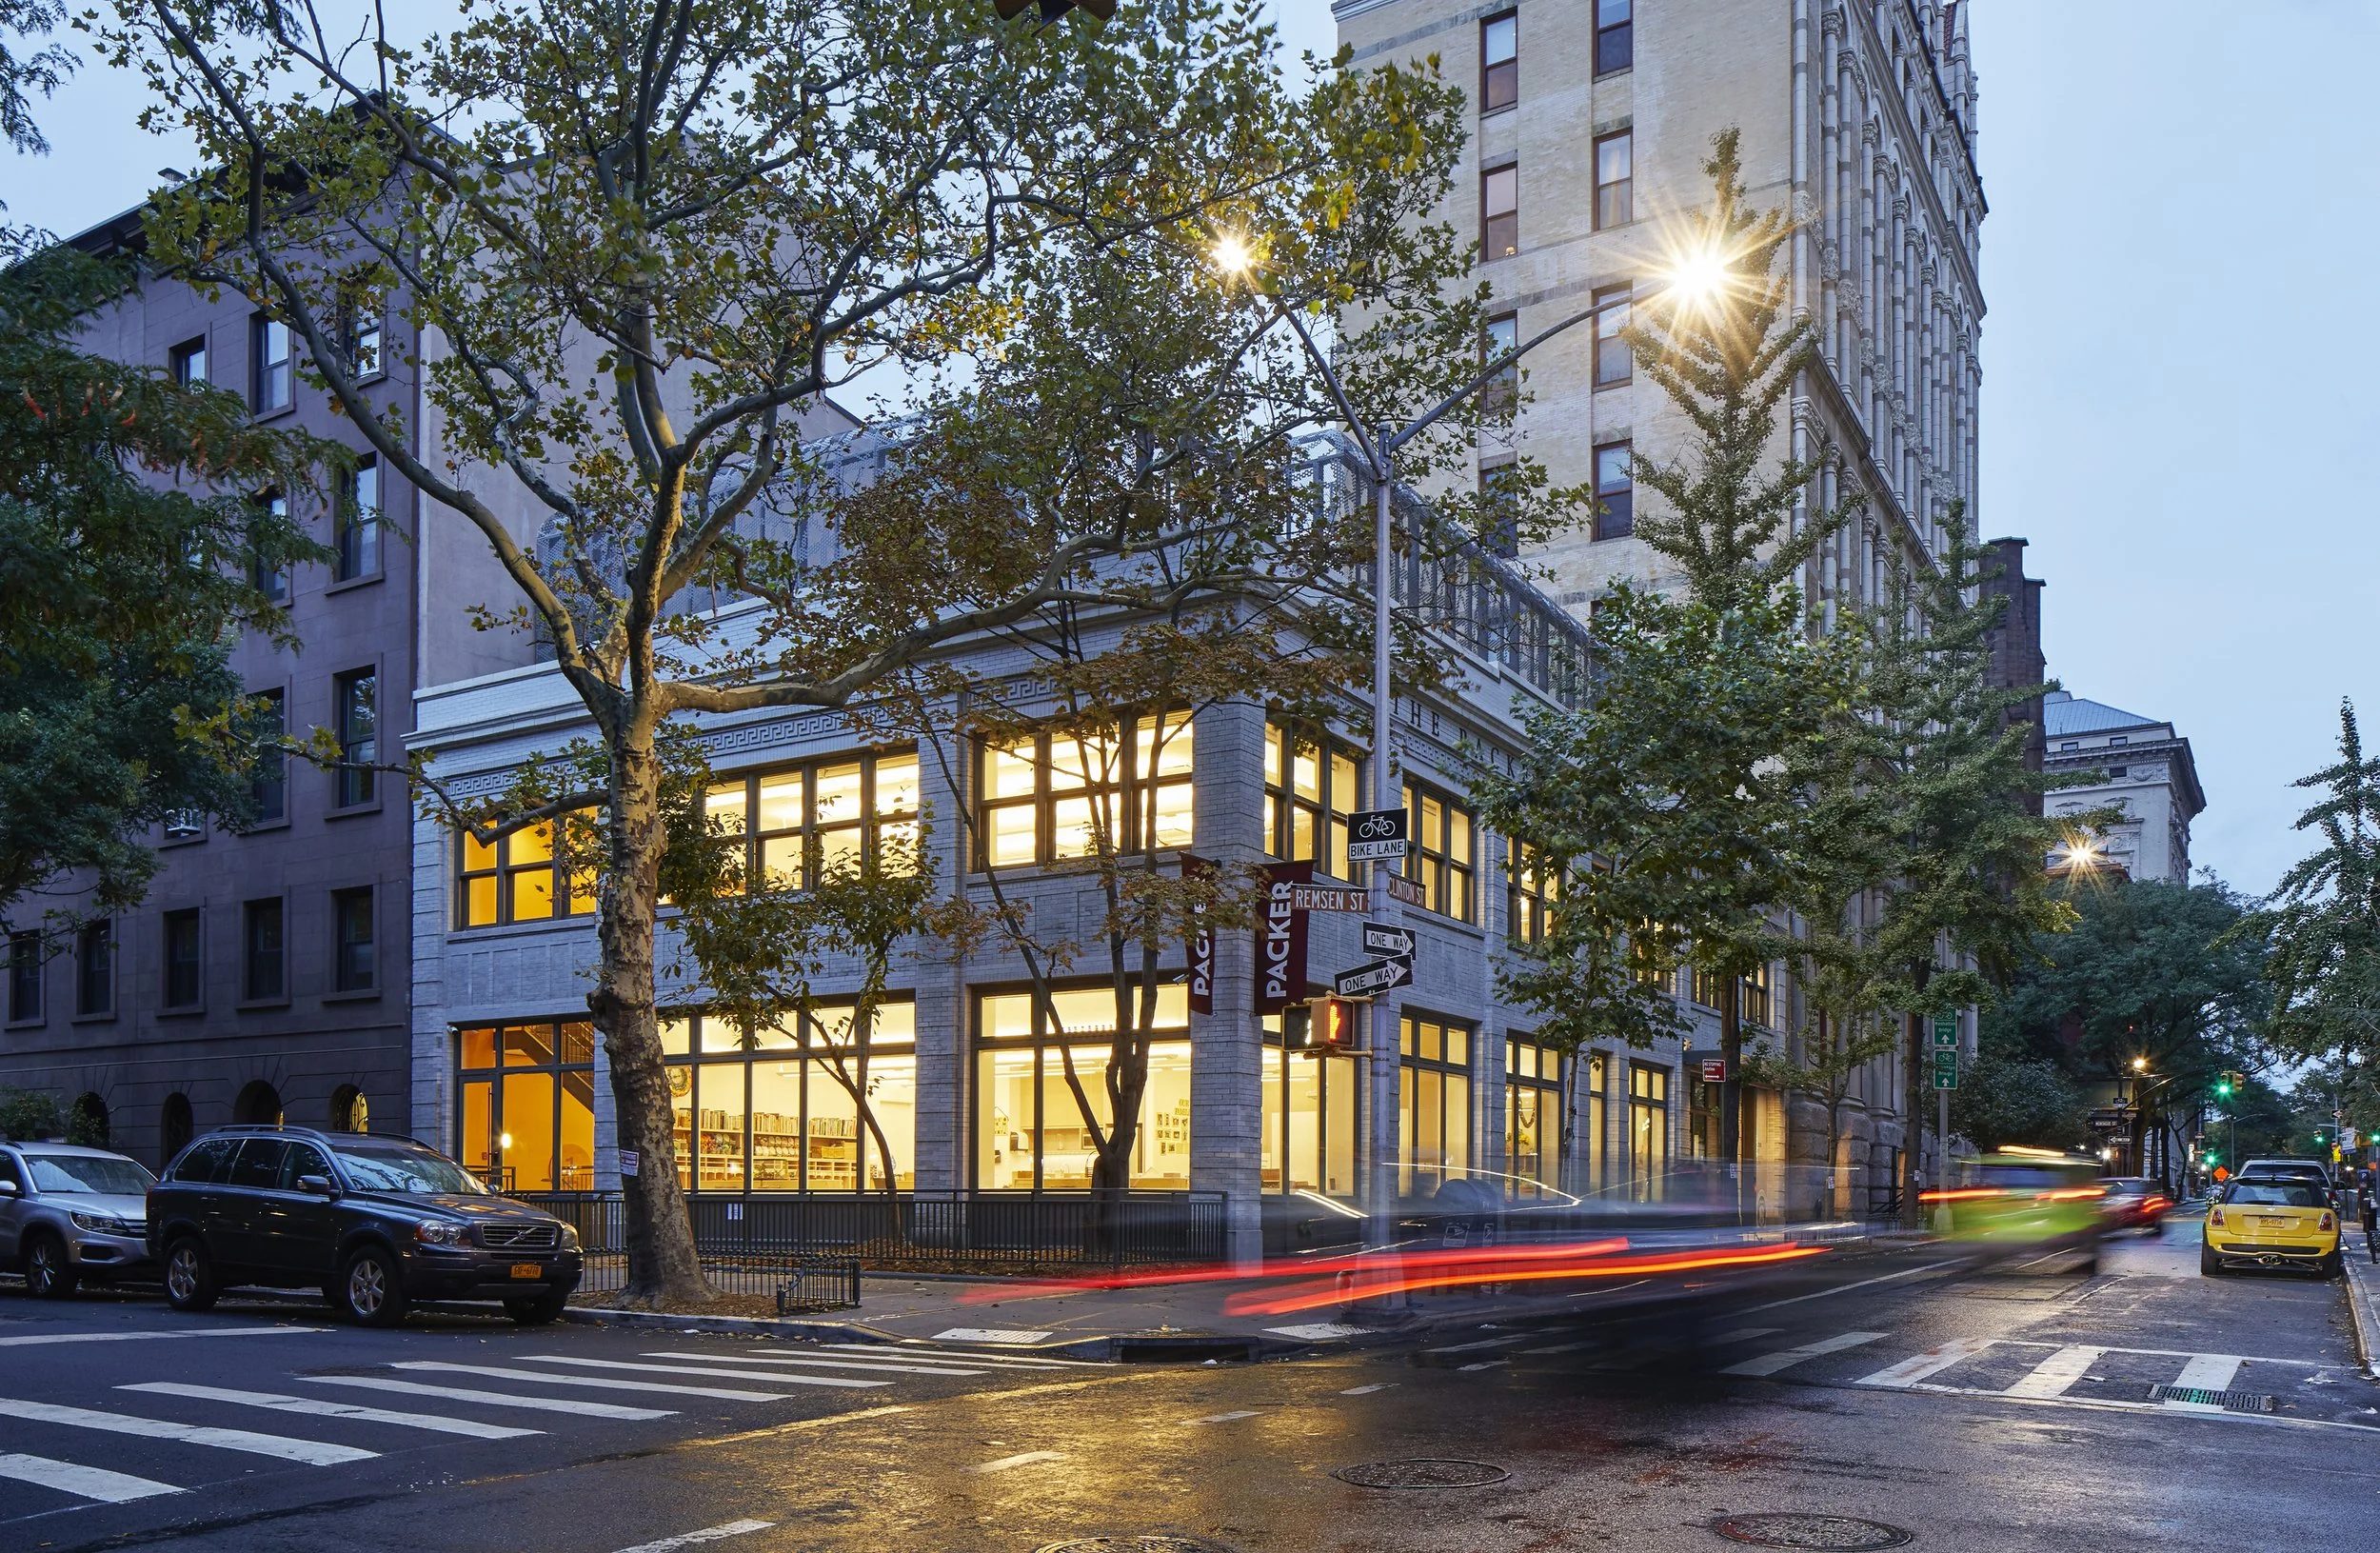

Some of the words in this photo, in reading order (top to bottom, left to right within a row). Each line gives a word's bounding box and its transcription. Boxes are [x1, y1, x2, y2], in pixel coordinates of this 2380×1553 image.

[1458, 727, 1527, 781] PACK
[1350, 844, 1372, 857] BIKE
[1377, 841, 1403, 854] LANE
[1296, 889, 1343, 909] REMSEN
[1350, 892, 1364, 910] ST
[1388, 876, 1414, 902] CLINTON
[1416, 886, 1423, 905] ST
[1194, 899, 1210, 996] PACE
[1265, 880, 1293, 998] PACKER
[1371, 932, 1386, 946] ONE
[1393, 936, 1408, 950] WAY
[1345, 975, 1366, 991] ONE
[1375, 966, 1398, 983] WAY
